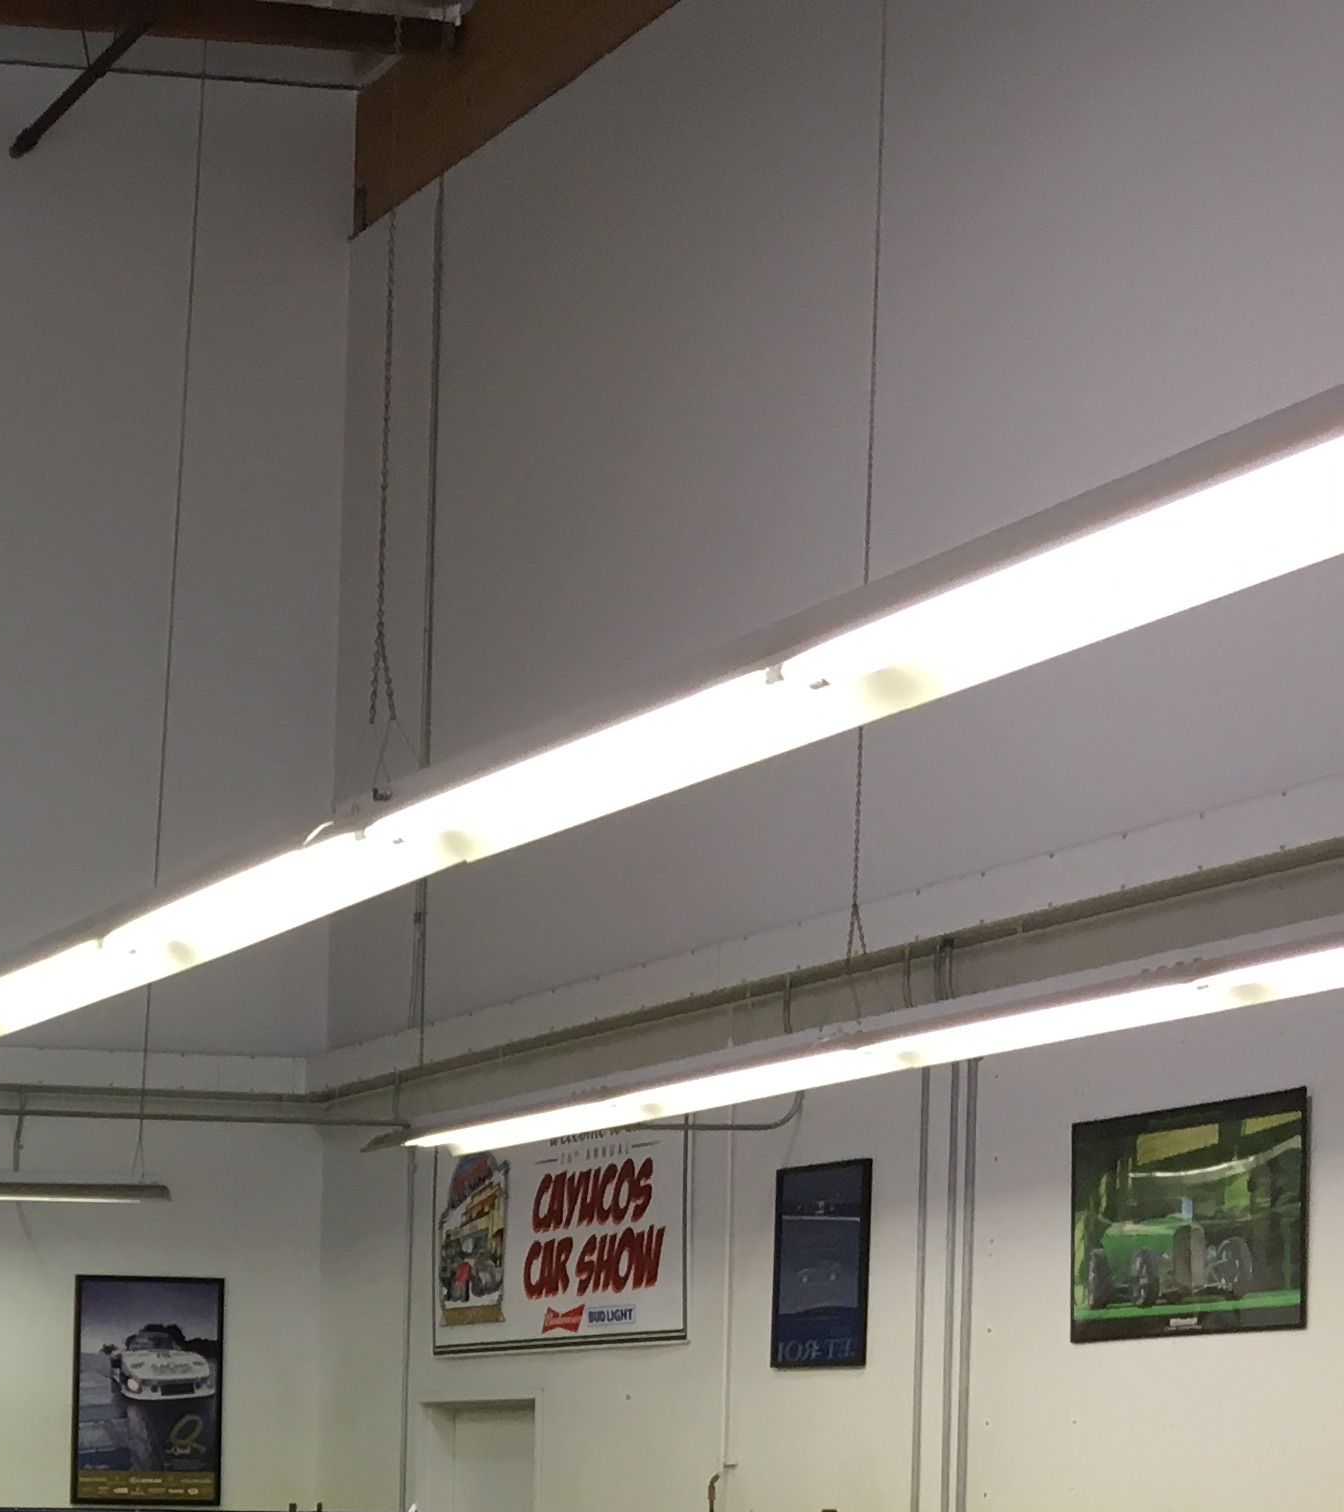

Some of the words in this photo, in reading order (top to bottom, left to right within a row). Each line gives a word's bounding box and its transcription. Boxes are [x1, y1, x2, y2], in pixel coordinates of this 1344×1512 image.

[532, 1157, 654, 1234] CAYUCOS
[522, 1236, 574, 1301] CAR
[575, 1224, 666, 1297] SHOW
[588, 1310, 606, 1324] BUD
[606, 1307, 634, 1322] LIGHT
